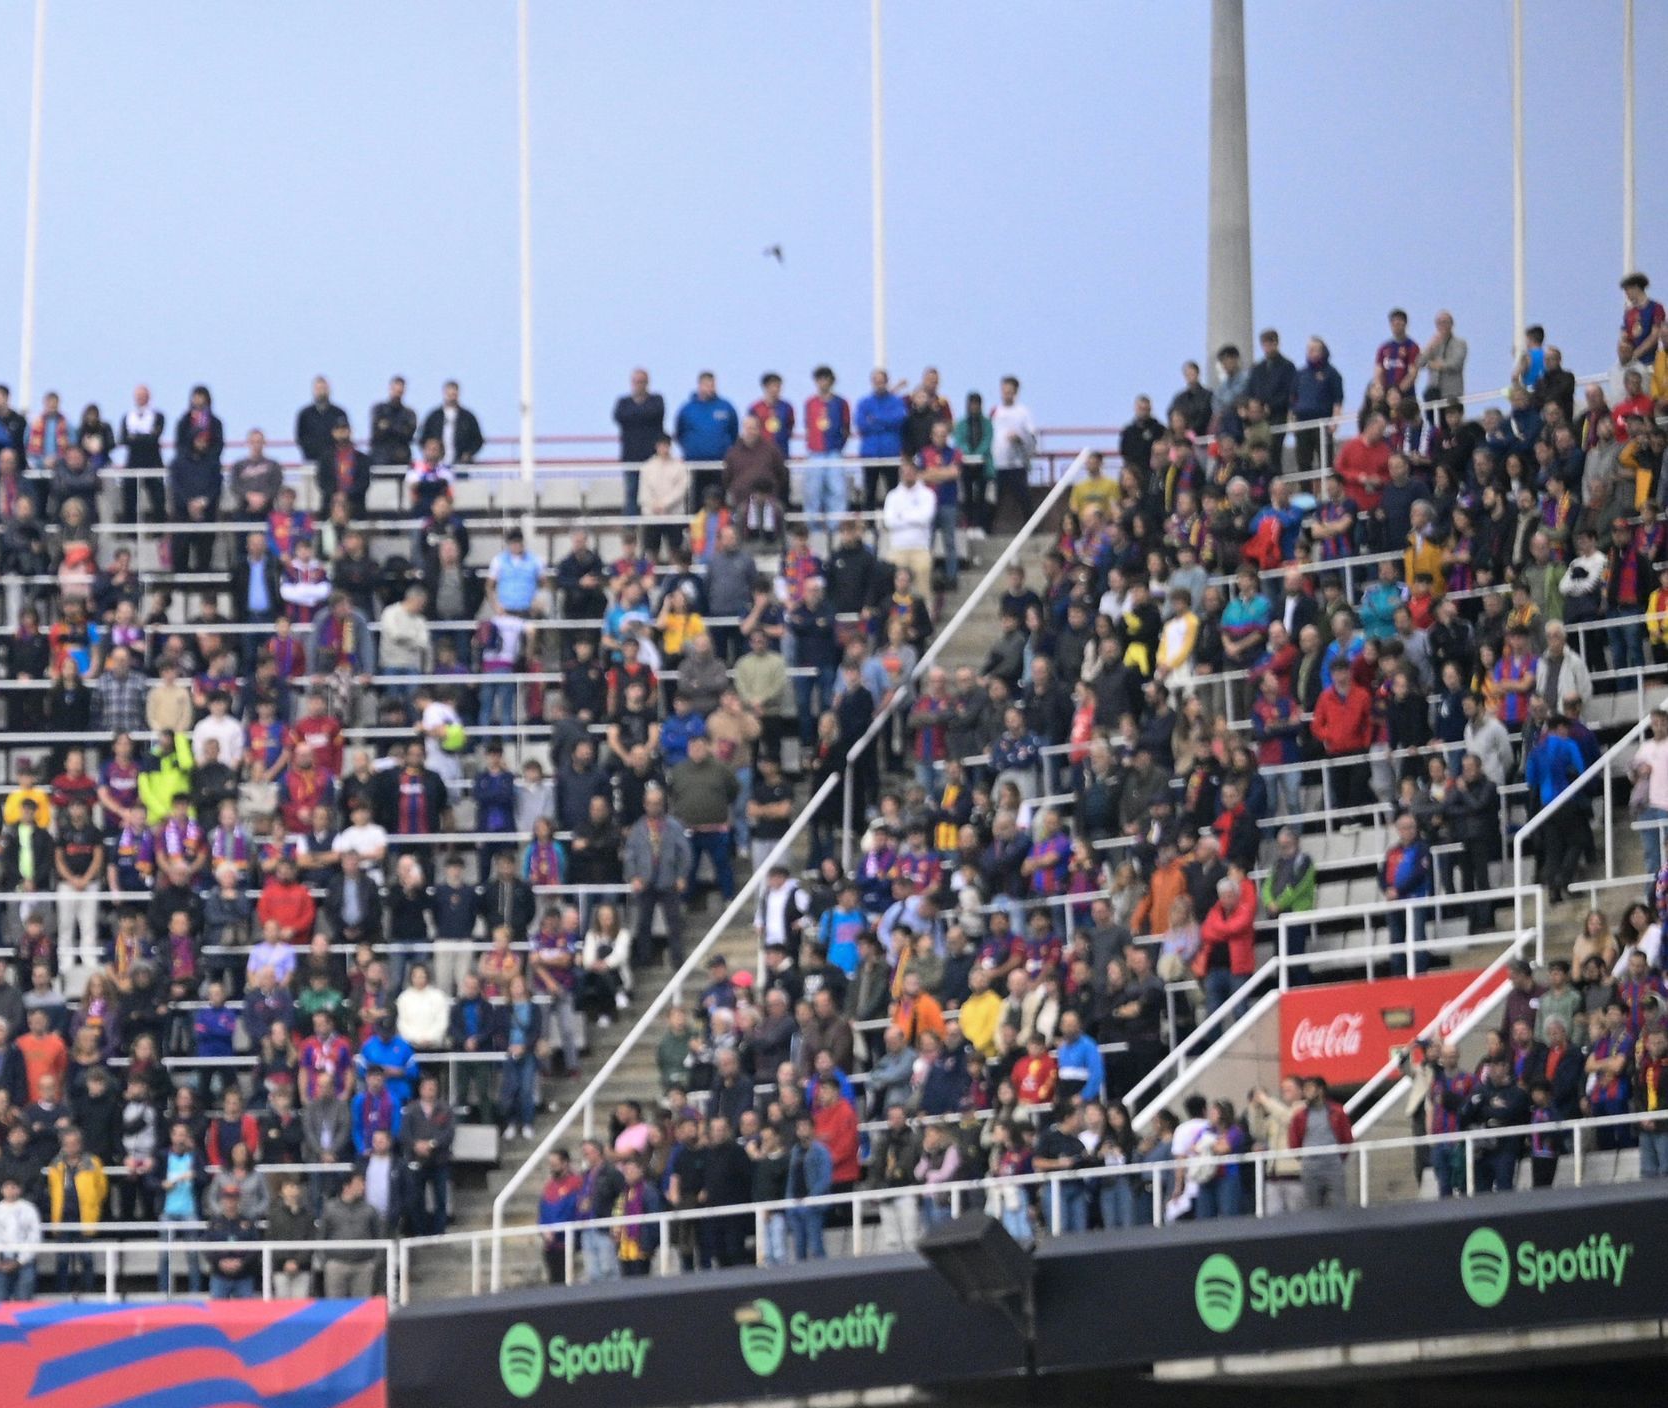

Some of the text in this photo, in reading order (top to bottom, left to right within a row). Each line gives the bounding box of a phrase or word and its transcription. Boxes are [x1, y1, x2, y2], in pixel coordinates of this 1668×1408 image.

[1249, 1257, 1359, 1318] Spotify
[1516, 1231, 1632, 1293] Spotify
[549, 1327, 653, 1384] Spotify
[790, 1302, 897, 1360] Spotify
